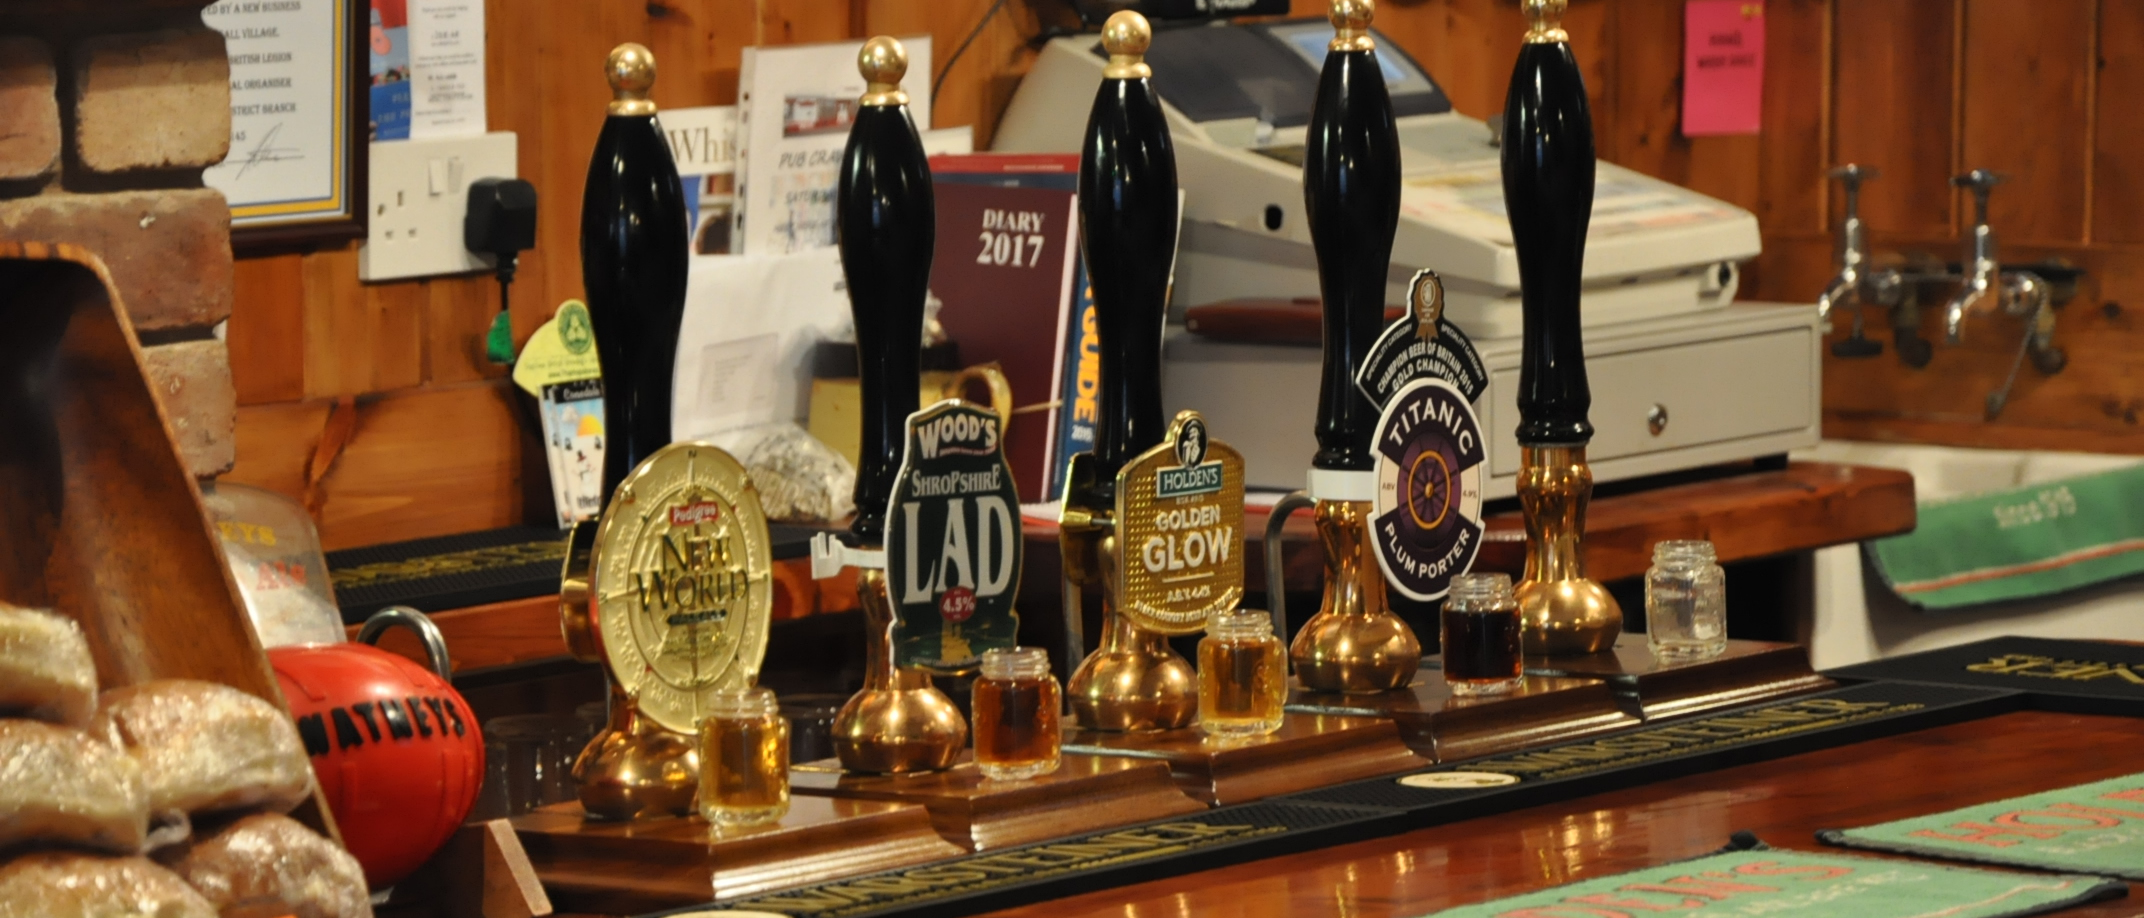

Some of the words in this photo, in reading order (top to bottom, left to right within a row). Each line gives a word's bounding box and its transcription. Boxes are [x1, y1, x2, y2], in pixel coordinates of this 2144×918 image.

[242, 3, 261, 13] NEW
[262, 1, 301, 12] BUSINESS
[262, 52, 292, 63] LEGION
[244, 77, 292, 89] ORGANISER
[262, 102, 297, 113] BRANCH
[778, 151, 807, 169] PUB
[981, 208, 1045, 233] DIARY
[976, 231, 1045, 267] 2017
[1073, 304, 1100, 424] GUIDE
[1377, 348, 1409, 394] CHAMPION
[1408, 341, 1427, 360] BEER
[1427, 342, 1437, 356] OF
[1436, 344, 1462, 375] BRITAIN
[1392, 362, 1414, 392] GOLD
[1416, 358, 1460, 389] CHAMPION
[918, 413, 997, 460] WOOD'S
[1389, 397, 1474, 456] TITANIC
[1163, 467, 1219, 491] HOLDEN'S
[1382, 482, 1396, 491] ABV
[673, 506, 717, 526] Pedigree
[1155, 504, 1221, 532] GOLDEN
[662, 532, 731, 577] NEW
[902, 495, 1014, 604] LAD
[1142, 526, 1233, 572] GLOW
[1384, 521, 1416, 576] PLUM
[1418, 527, 1471, 580] PORTER
[634, 568, 749, 613] WORLD
[943, 596, 975, 612] 4.5%
